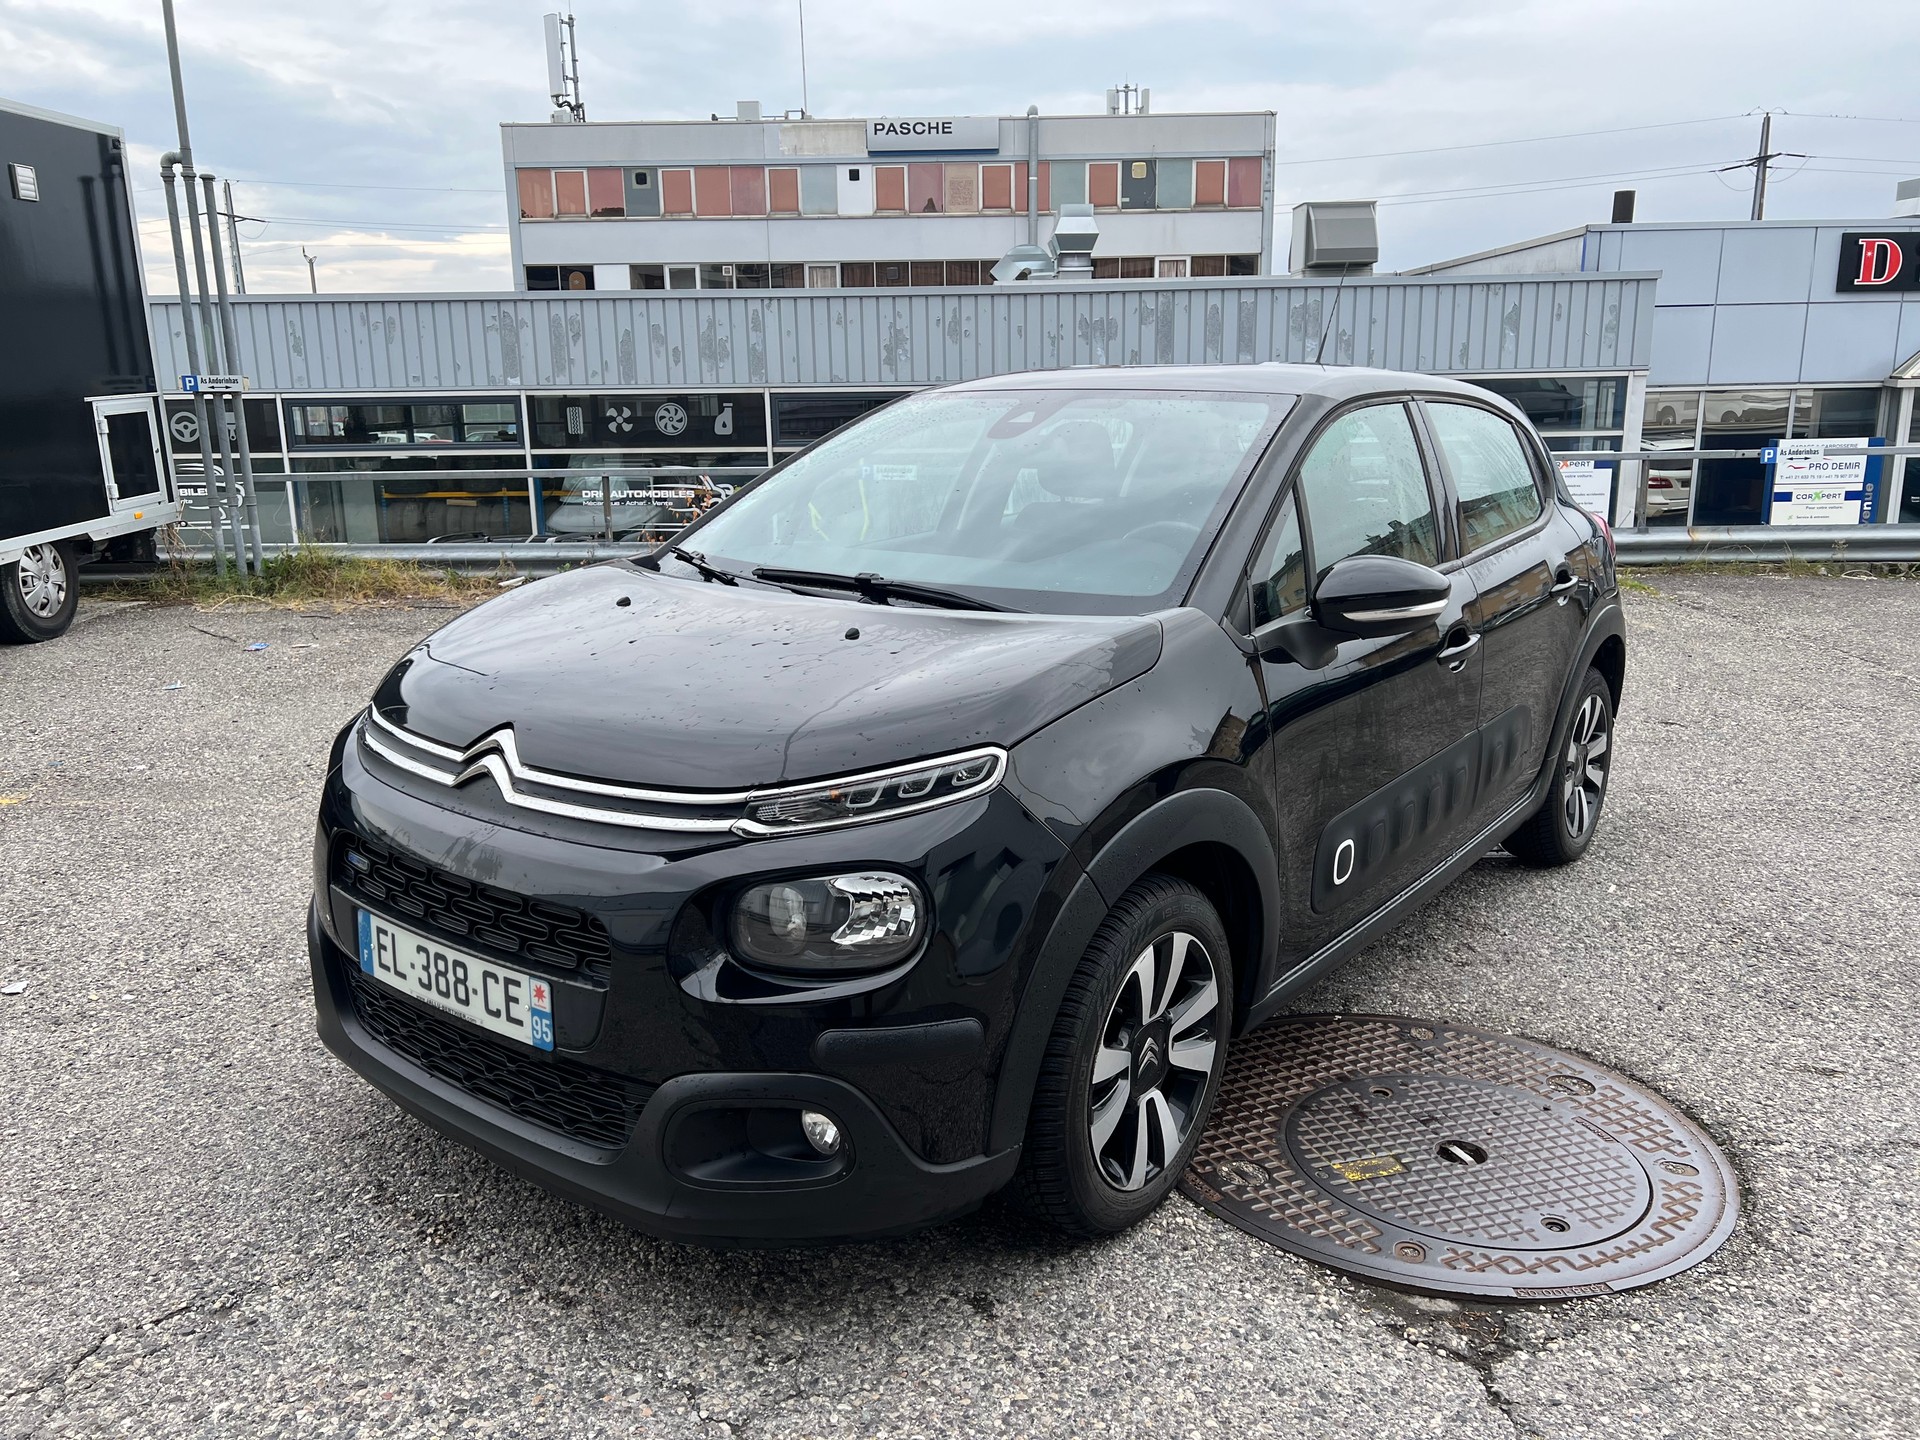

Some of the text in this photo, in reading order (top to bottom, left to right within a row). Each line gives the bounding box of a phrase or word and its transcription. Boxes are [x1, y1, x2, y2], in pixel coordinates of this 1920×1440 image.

[873, 121, 953, 136] PASCHE
[185, 377, 195, 391] P
[208, 377, 239, 385] Andorinhas
[1764, 449, 1774, 462] P
[1788, 448, 1820, 456] Andorinhas
[1831, 461, 1861, 470] DEMIR
[611, 489, 695, 499] AUTOMOBILES
[363, 949, 369, 962] F
[532, 1014, 551, 1043] 95
